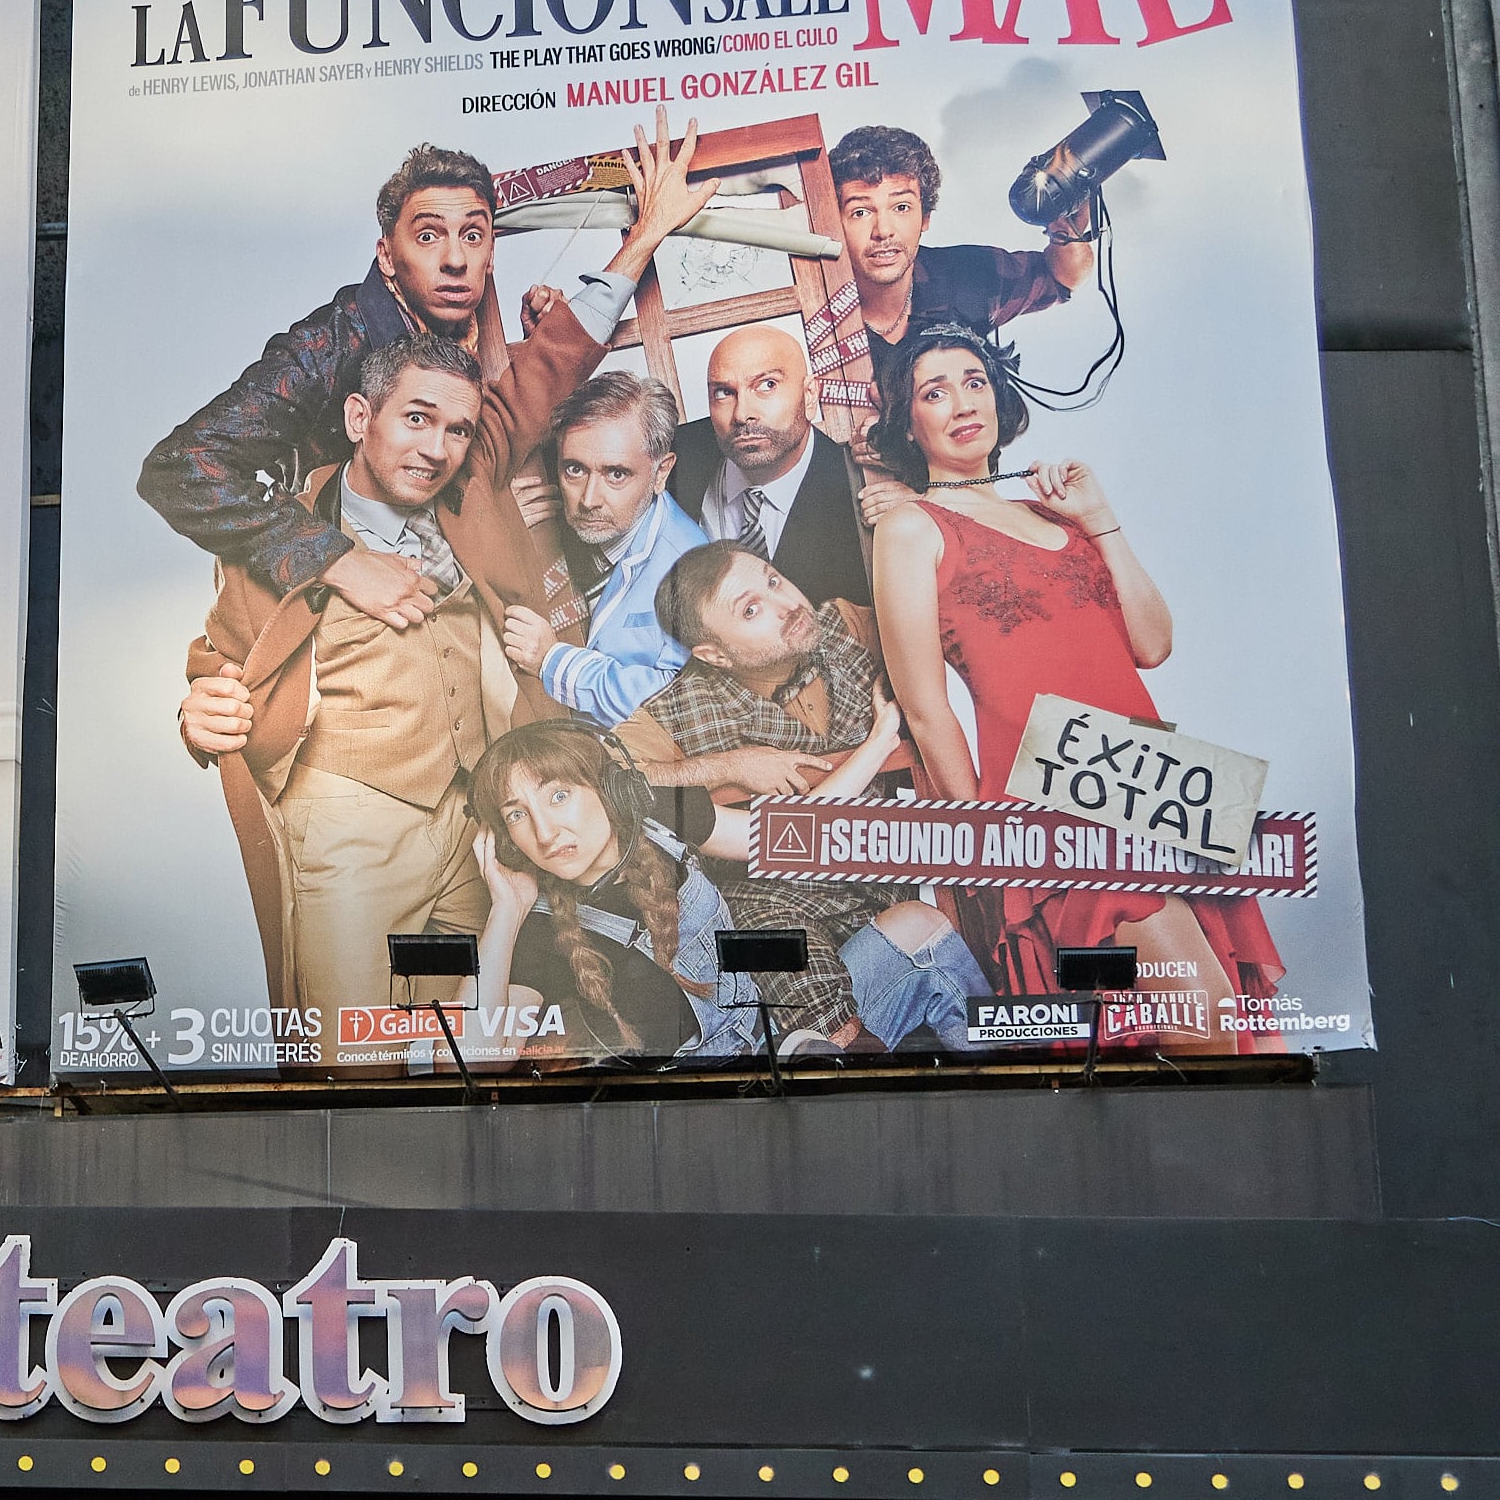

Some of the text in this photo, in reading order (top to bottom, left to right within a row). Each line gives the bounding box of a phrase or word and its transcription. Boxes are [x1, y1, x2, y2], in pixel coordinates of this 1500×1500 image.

[129, 0, 210, 67] LA
[462, 62, 879, 114] DIRECCIÓN MANUEL GONZÁLEZ GIL
[1035, 757, 1236, 855] TOTAL
[820, 816, 1107, 871] ¡SEGUNDO AÑO SIN
[978, 1003, 1079, 1025] FARONI
[1219, 1012, 1351, 1032] Rottemberg
[1237, 995, 1302, 1012] Tomás
[979, 1026, 1078, 1038] PRODUCCIONES
